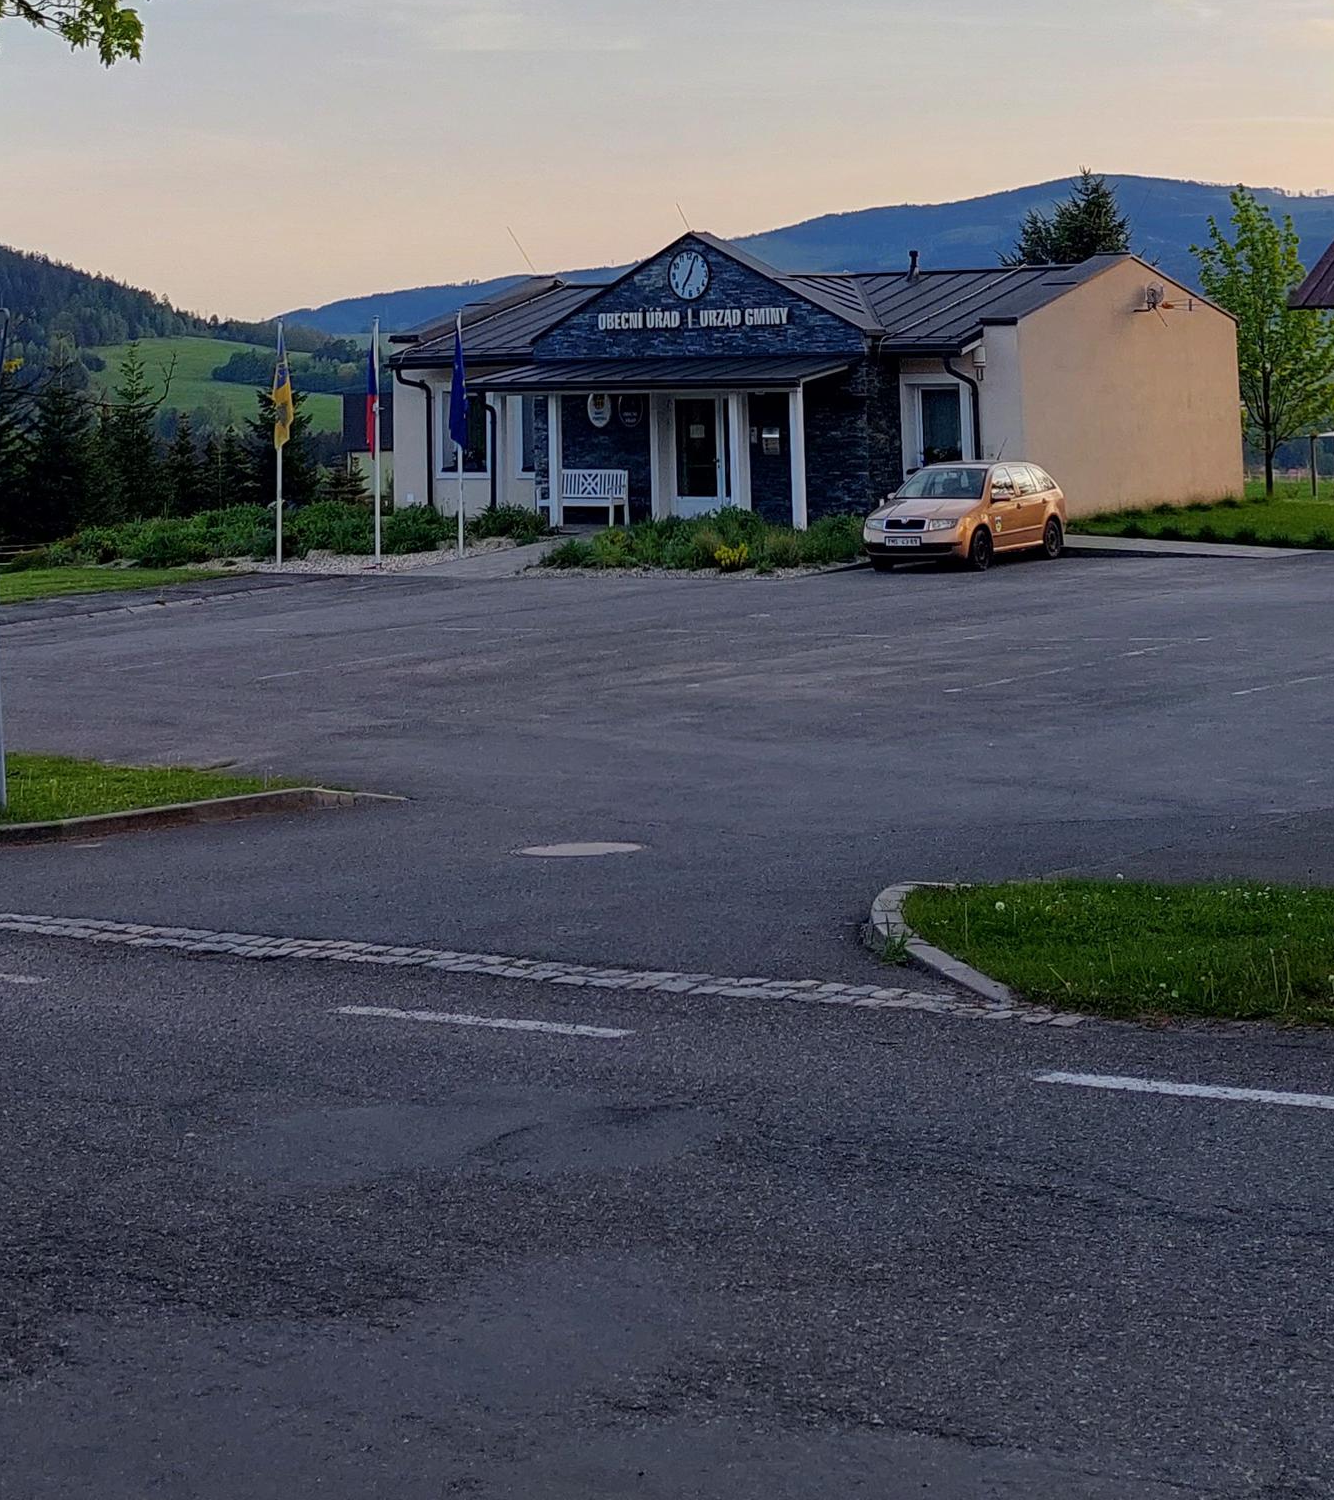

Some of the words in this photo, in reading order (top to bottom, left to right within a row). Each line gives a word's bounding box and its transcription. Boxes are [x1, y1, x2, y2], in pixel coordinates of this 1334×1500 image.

[598, 309, 643, 330] OBECNÍ
[646, 308, 680, 328] ÚŘAD
[699, 309, 741, 328] URZĄD
[745, 306, 788, 325] GMINY
